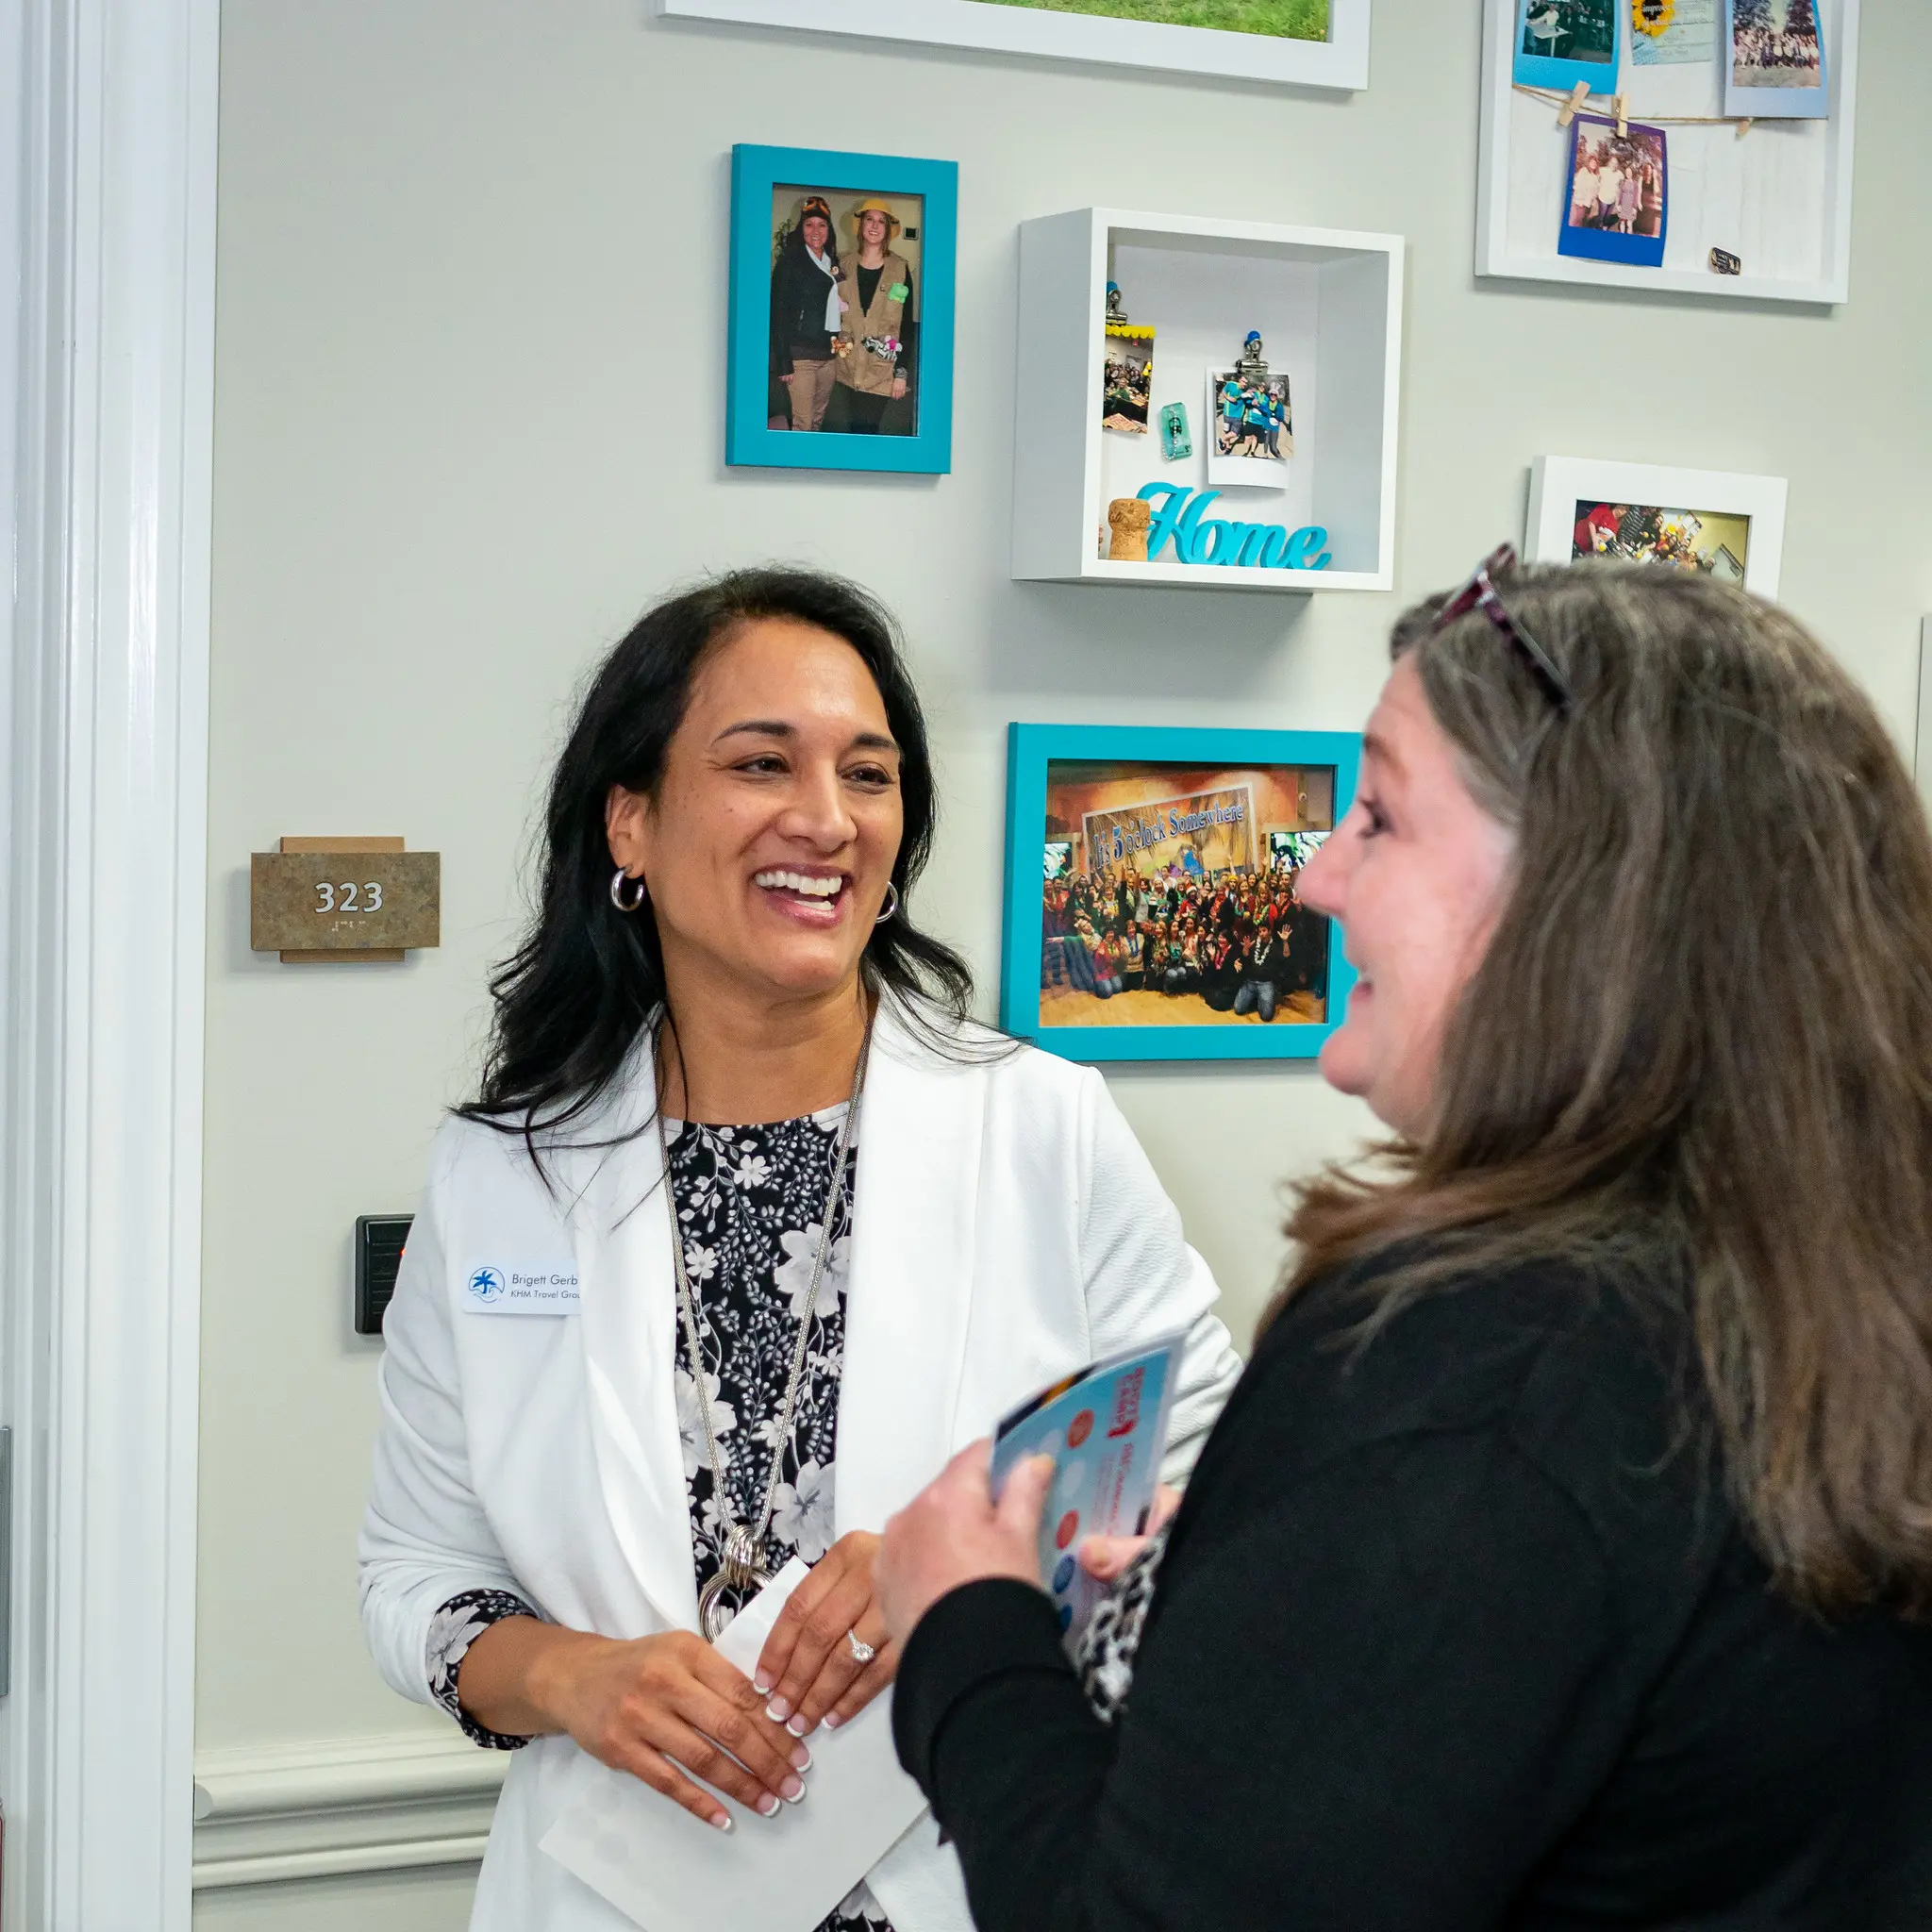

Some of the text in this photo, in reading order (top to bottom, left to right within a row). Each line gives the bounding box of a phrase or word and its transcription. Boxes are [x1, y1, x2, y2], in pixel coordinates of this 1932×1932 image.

[1135, 481, 1332, 571] Home
[1112, 825, 1124, 860] 5
[1126, 814, 1166, 854] o'clock
[1168, 801, 1244, 837] Somewhere
[314, 881, 384, 914] 323
[510, 1290, 532, 1298] KHM
[534, 1290, 558, 1299] Travel
[511, 1274, 578, 1287] Brigett Gerb
